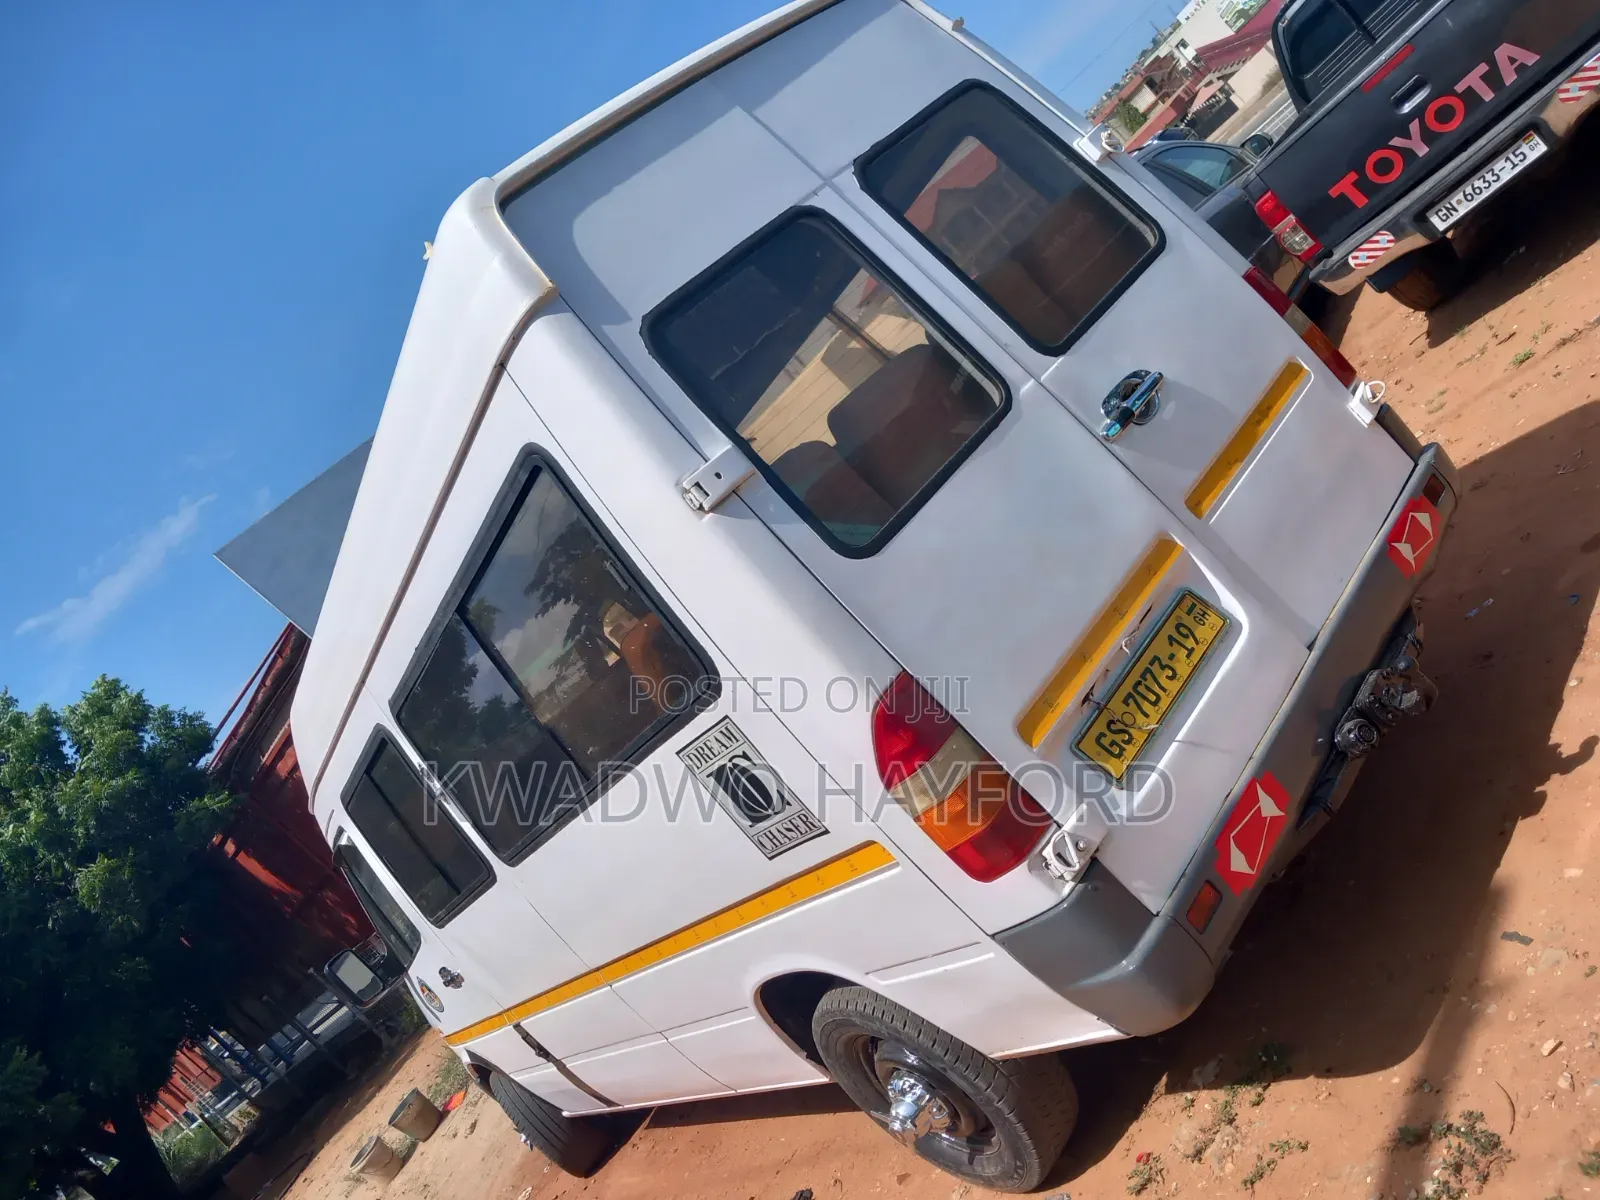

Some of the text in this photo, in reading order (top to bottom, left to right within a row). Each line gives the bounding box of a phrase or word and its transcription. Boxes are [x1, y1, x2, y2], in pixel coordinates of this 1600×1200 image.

[1328, 42, 1541, 209] TOYOTA
[1528, 139, 1541, 153] GH
[1435, 149, 1527, 223] GN 6633-15
[1193, 607, 1211, 627] GH
[1095, 622, 1199, 759] GS 7073-19
[685, 726, 741, 771] DREAM
[756, 813, 819, 852] CHASER
